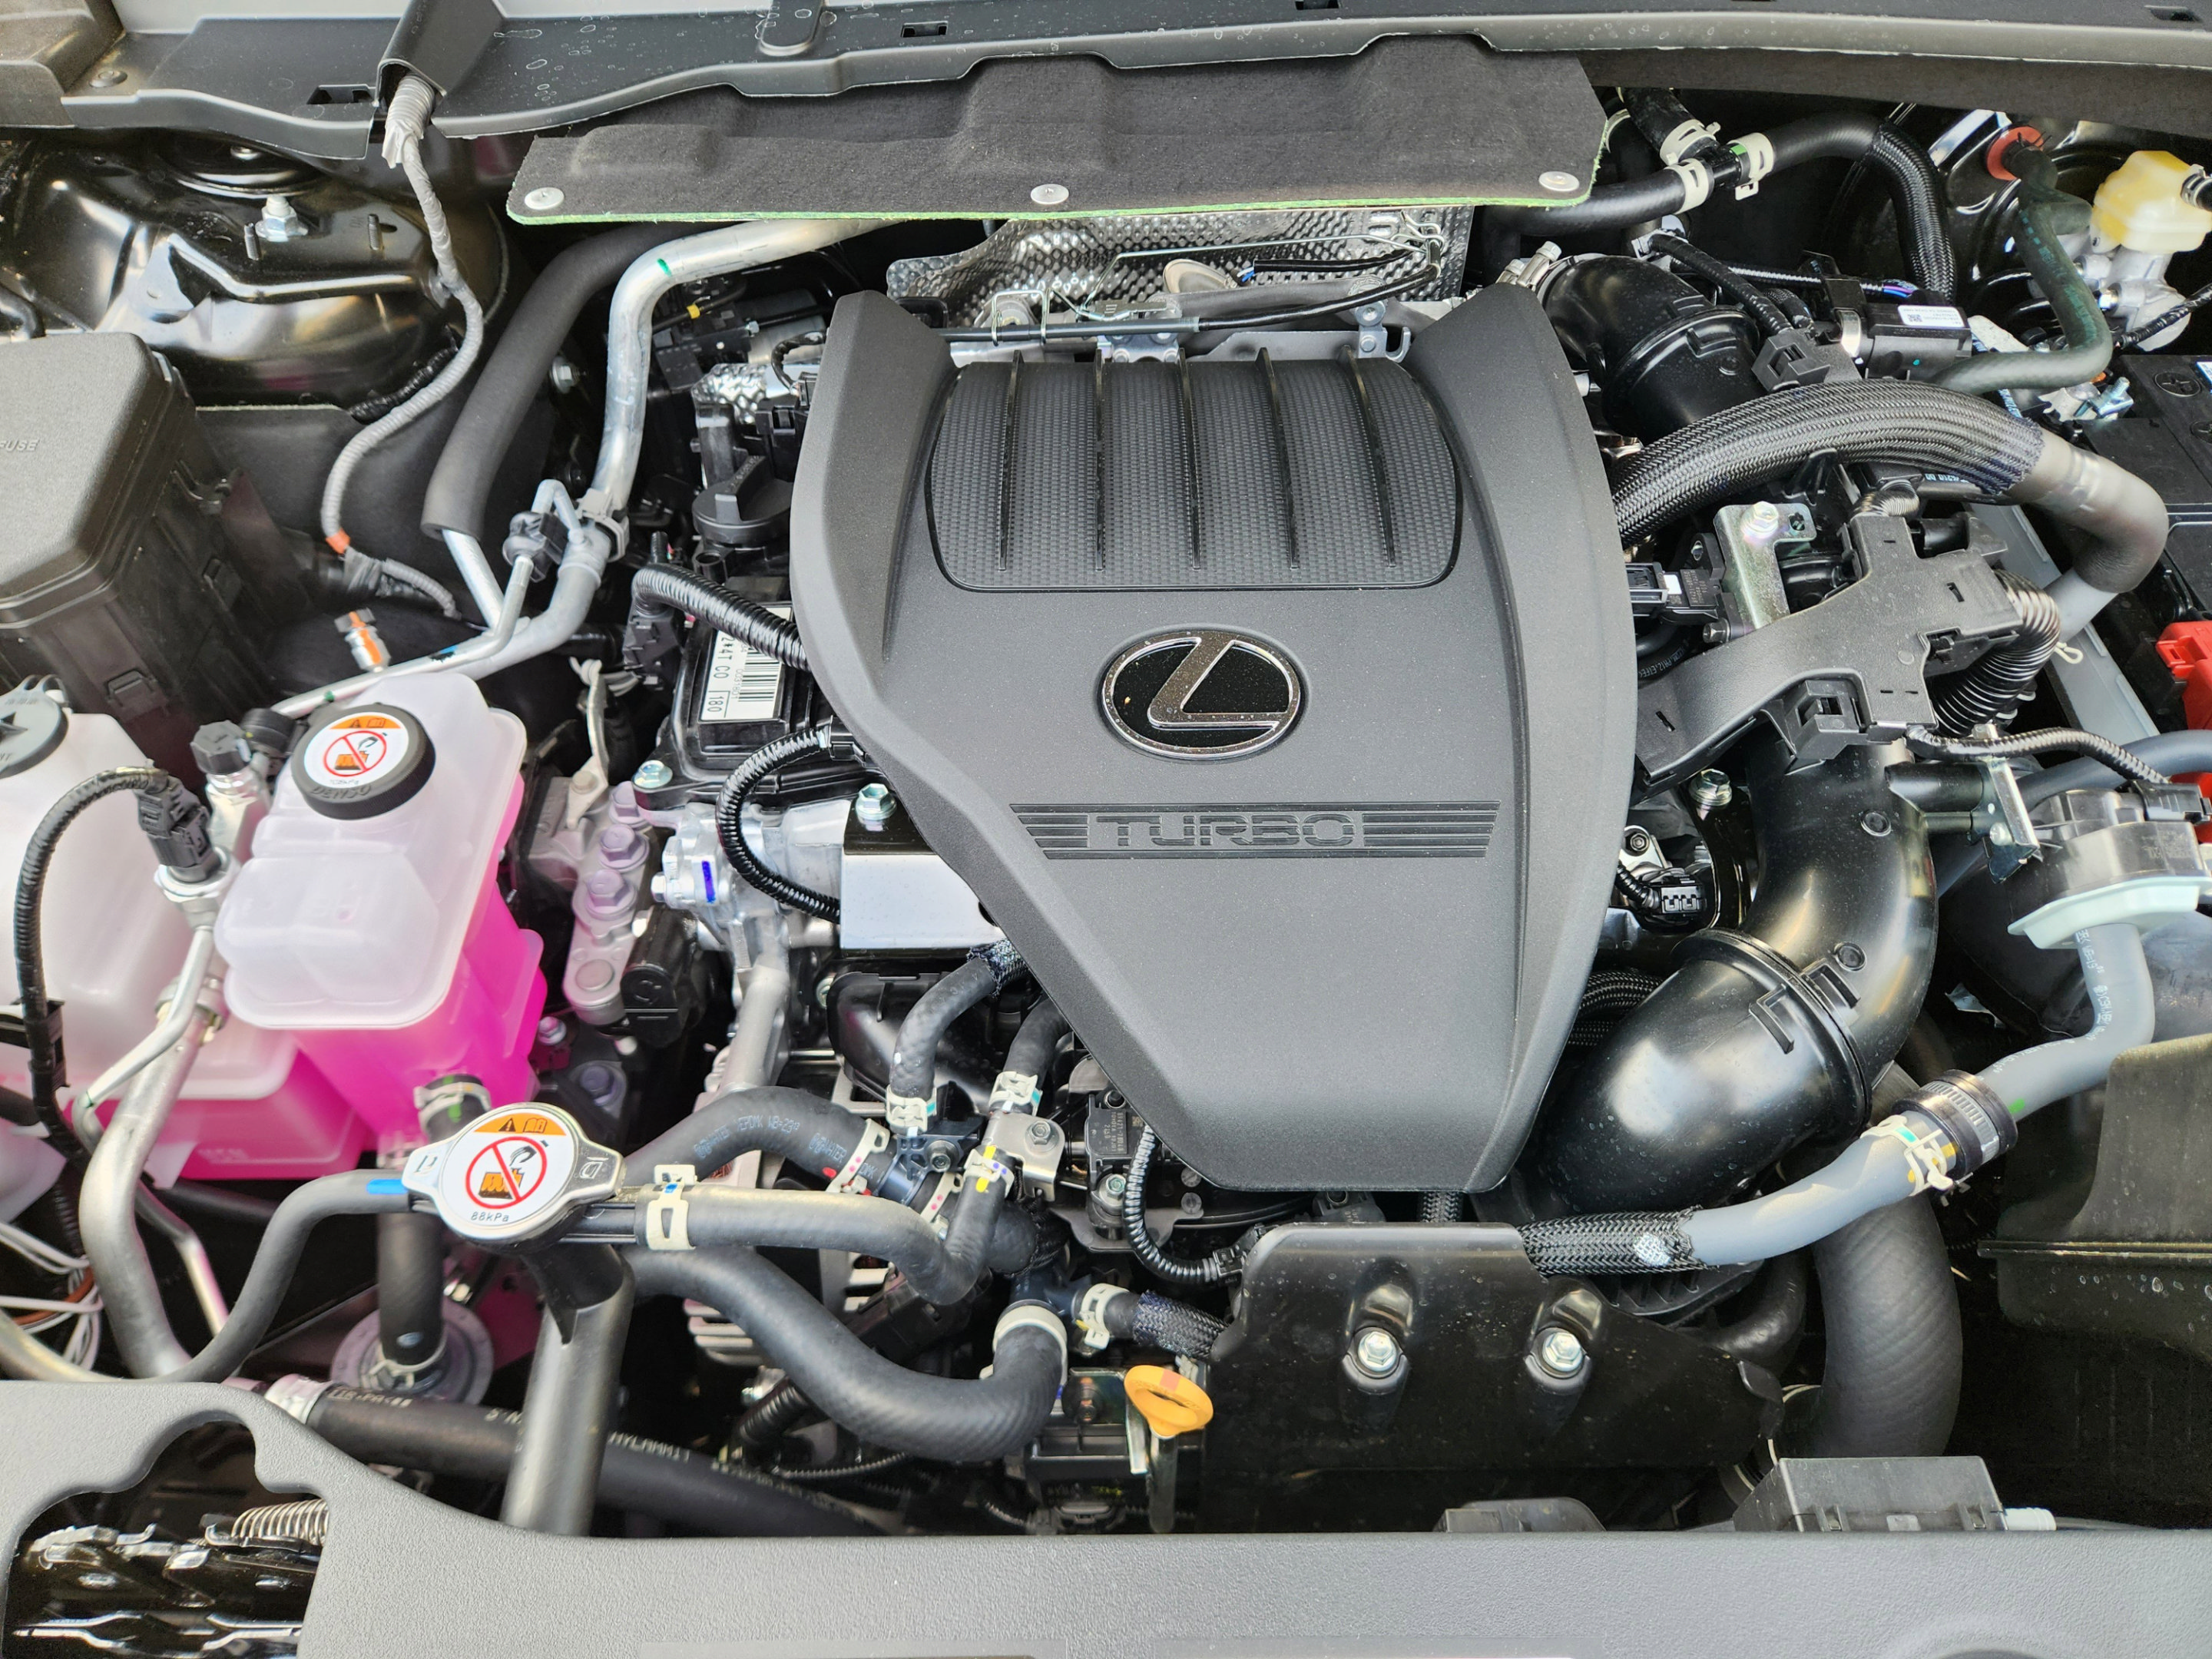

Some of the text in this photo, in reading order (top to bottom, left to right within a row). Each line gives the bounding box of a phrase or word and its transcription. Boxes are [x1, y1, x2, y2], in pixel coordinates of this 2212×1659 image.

[707, 695, 724, 712] 180
[310, 784, 371, 799] DENSO
[1096, 813, 1353, 846] TURBO
[470, 1210, 510, 1223] 88kPa
